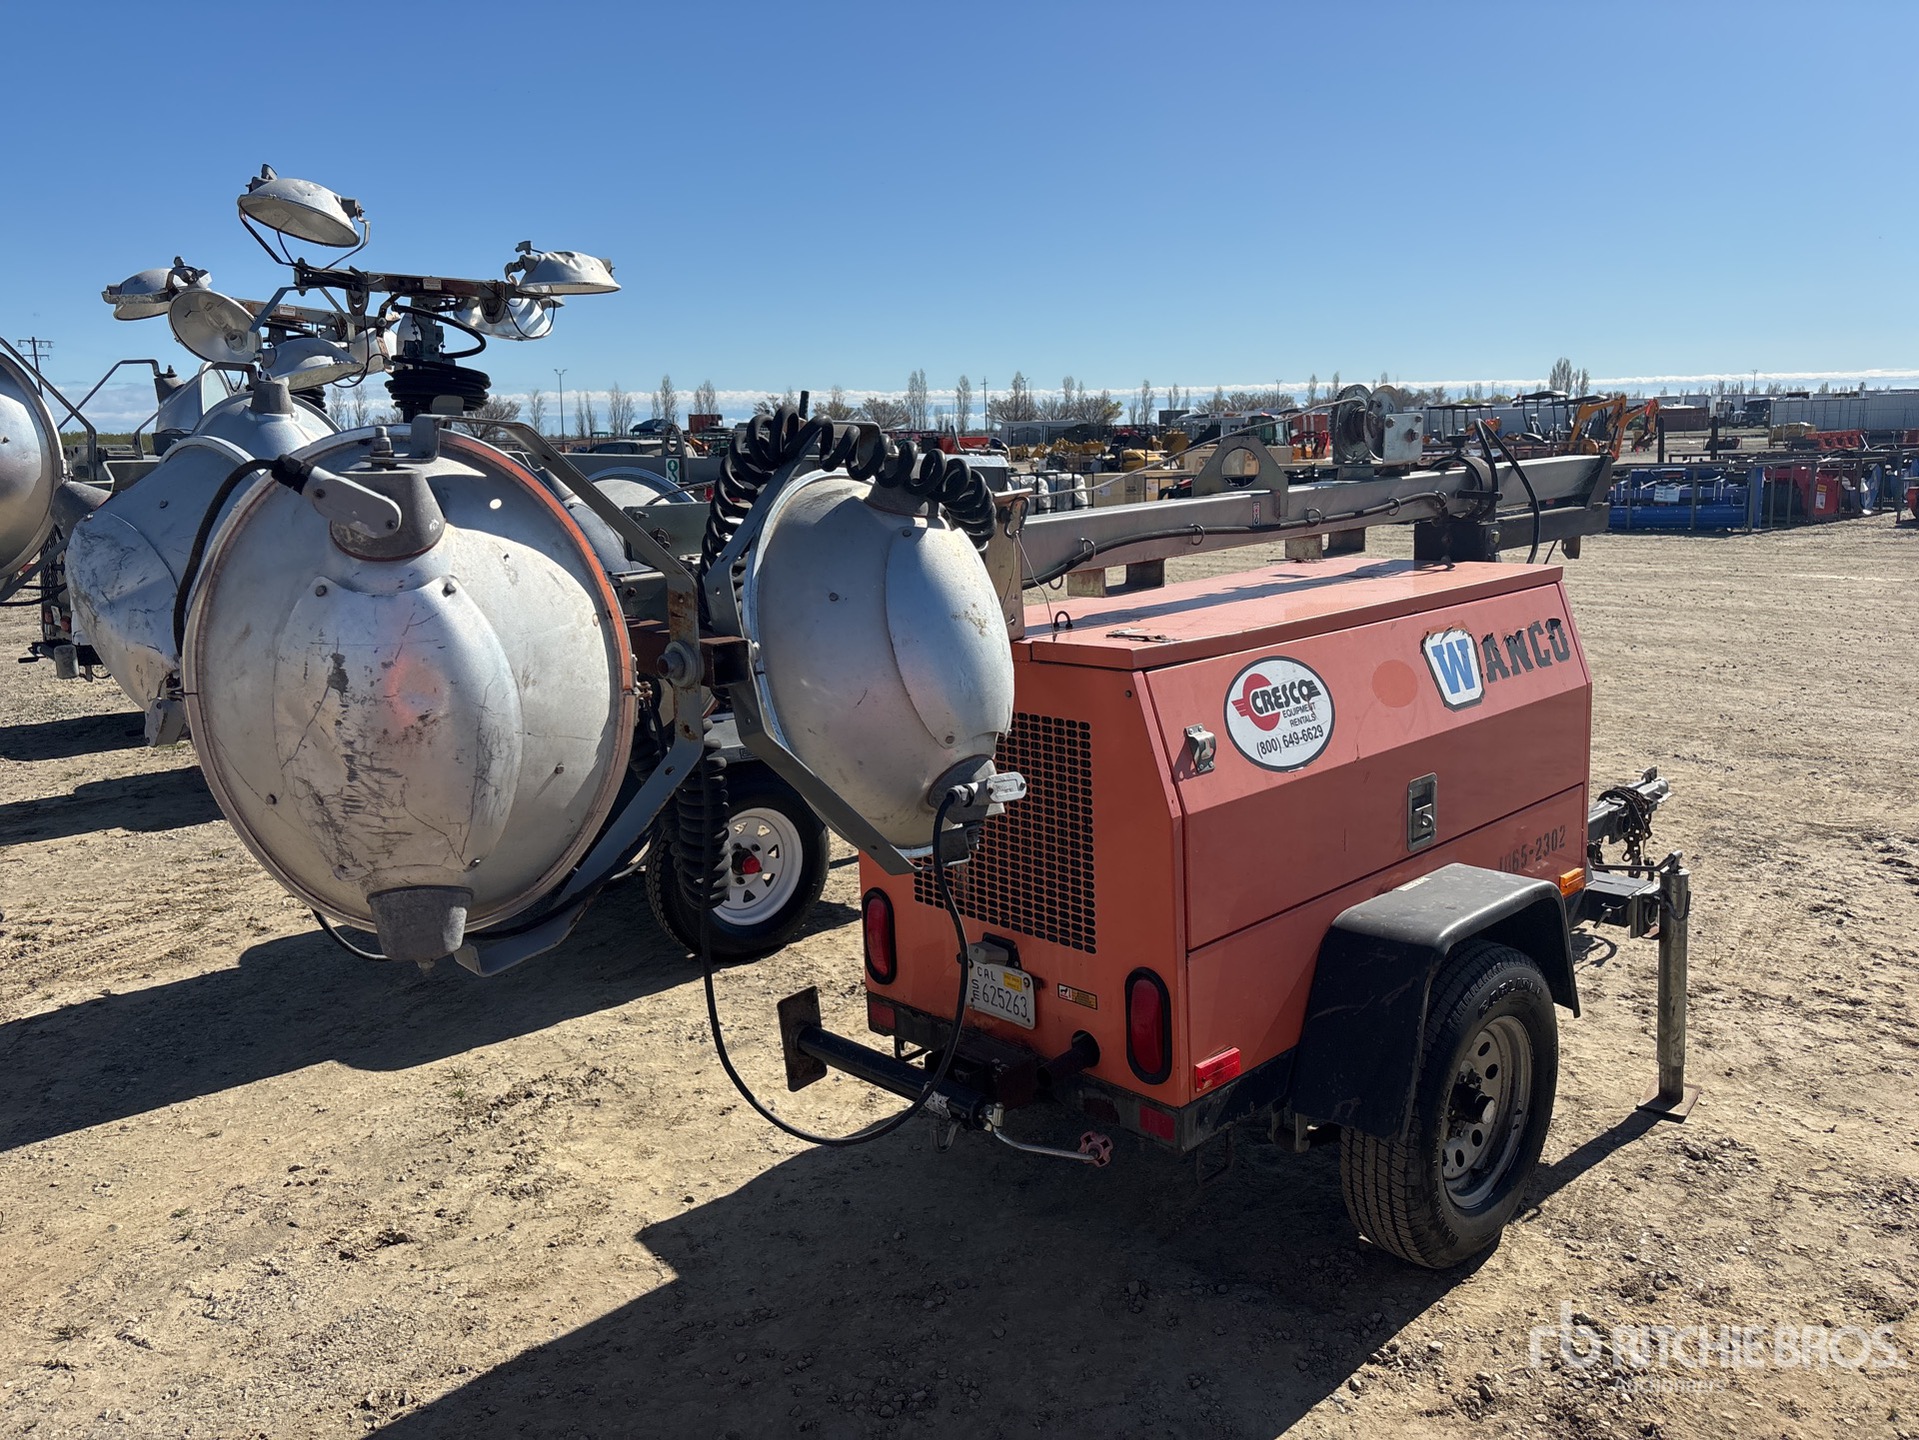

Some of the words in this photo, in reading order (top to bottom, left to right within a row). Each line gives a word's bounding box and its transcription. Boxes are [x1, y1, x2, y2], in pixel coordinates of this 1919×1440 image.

[1430, 618, 1570, 696] WANCO
[1251, 679, 1315, 715] CRESCO
[1289, 714, 1317, 728] RENTALS
[1256, 736, 1283, 759] (800)
[1282, 724, 1324, 748] 649-6629
[977, 966, 996, 982] CAL
[982, 983, 1028, 1018] 625263
